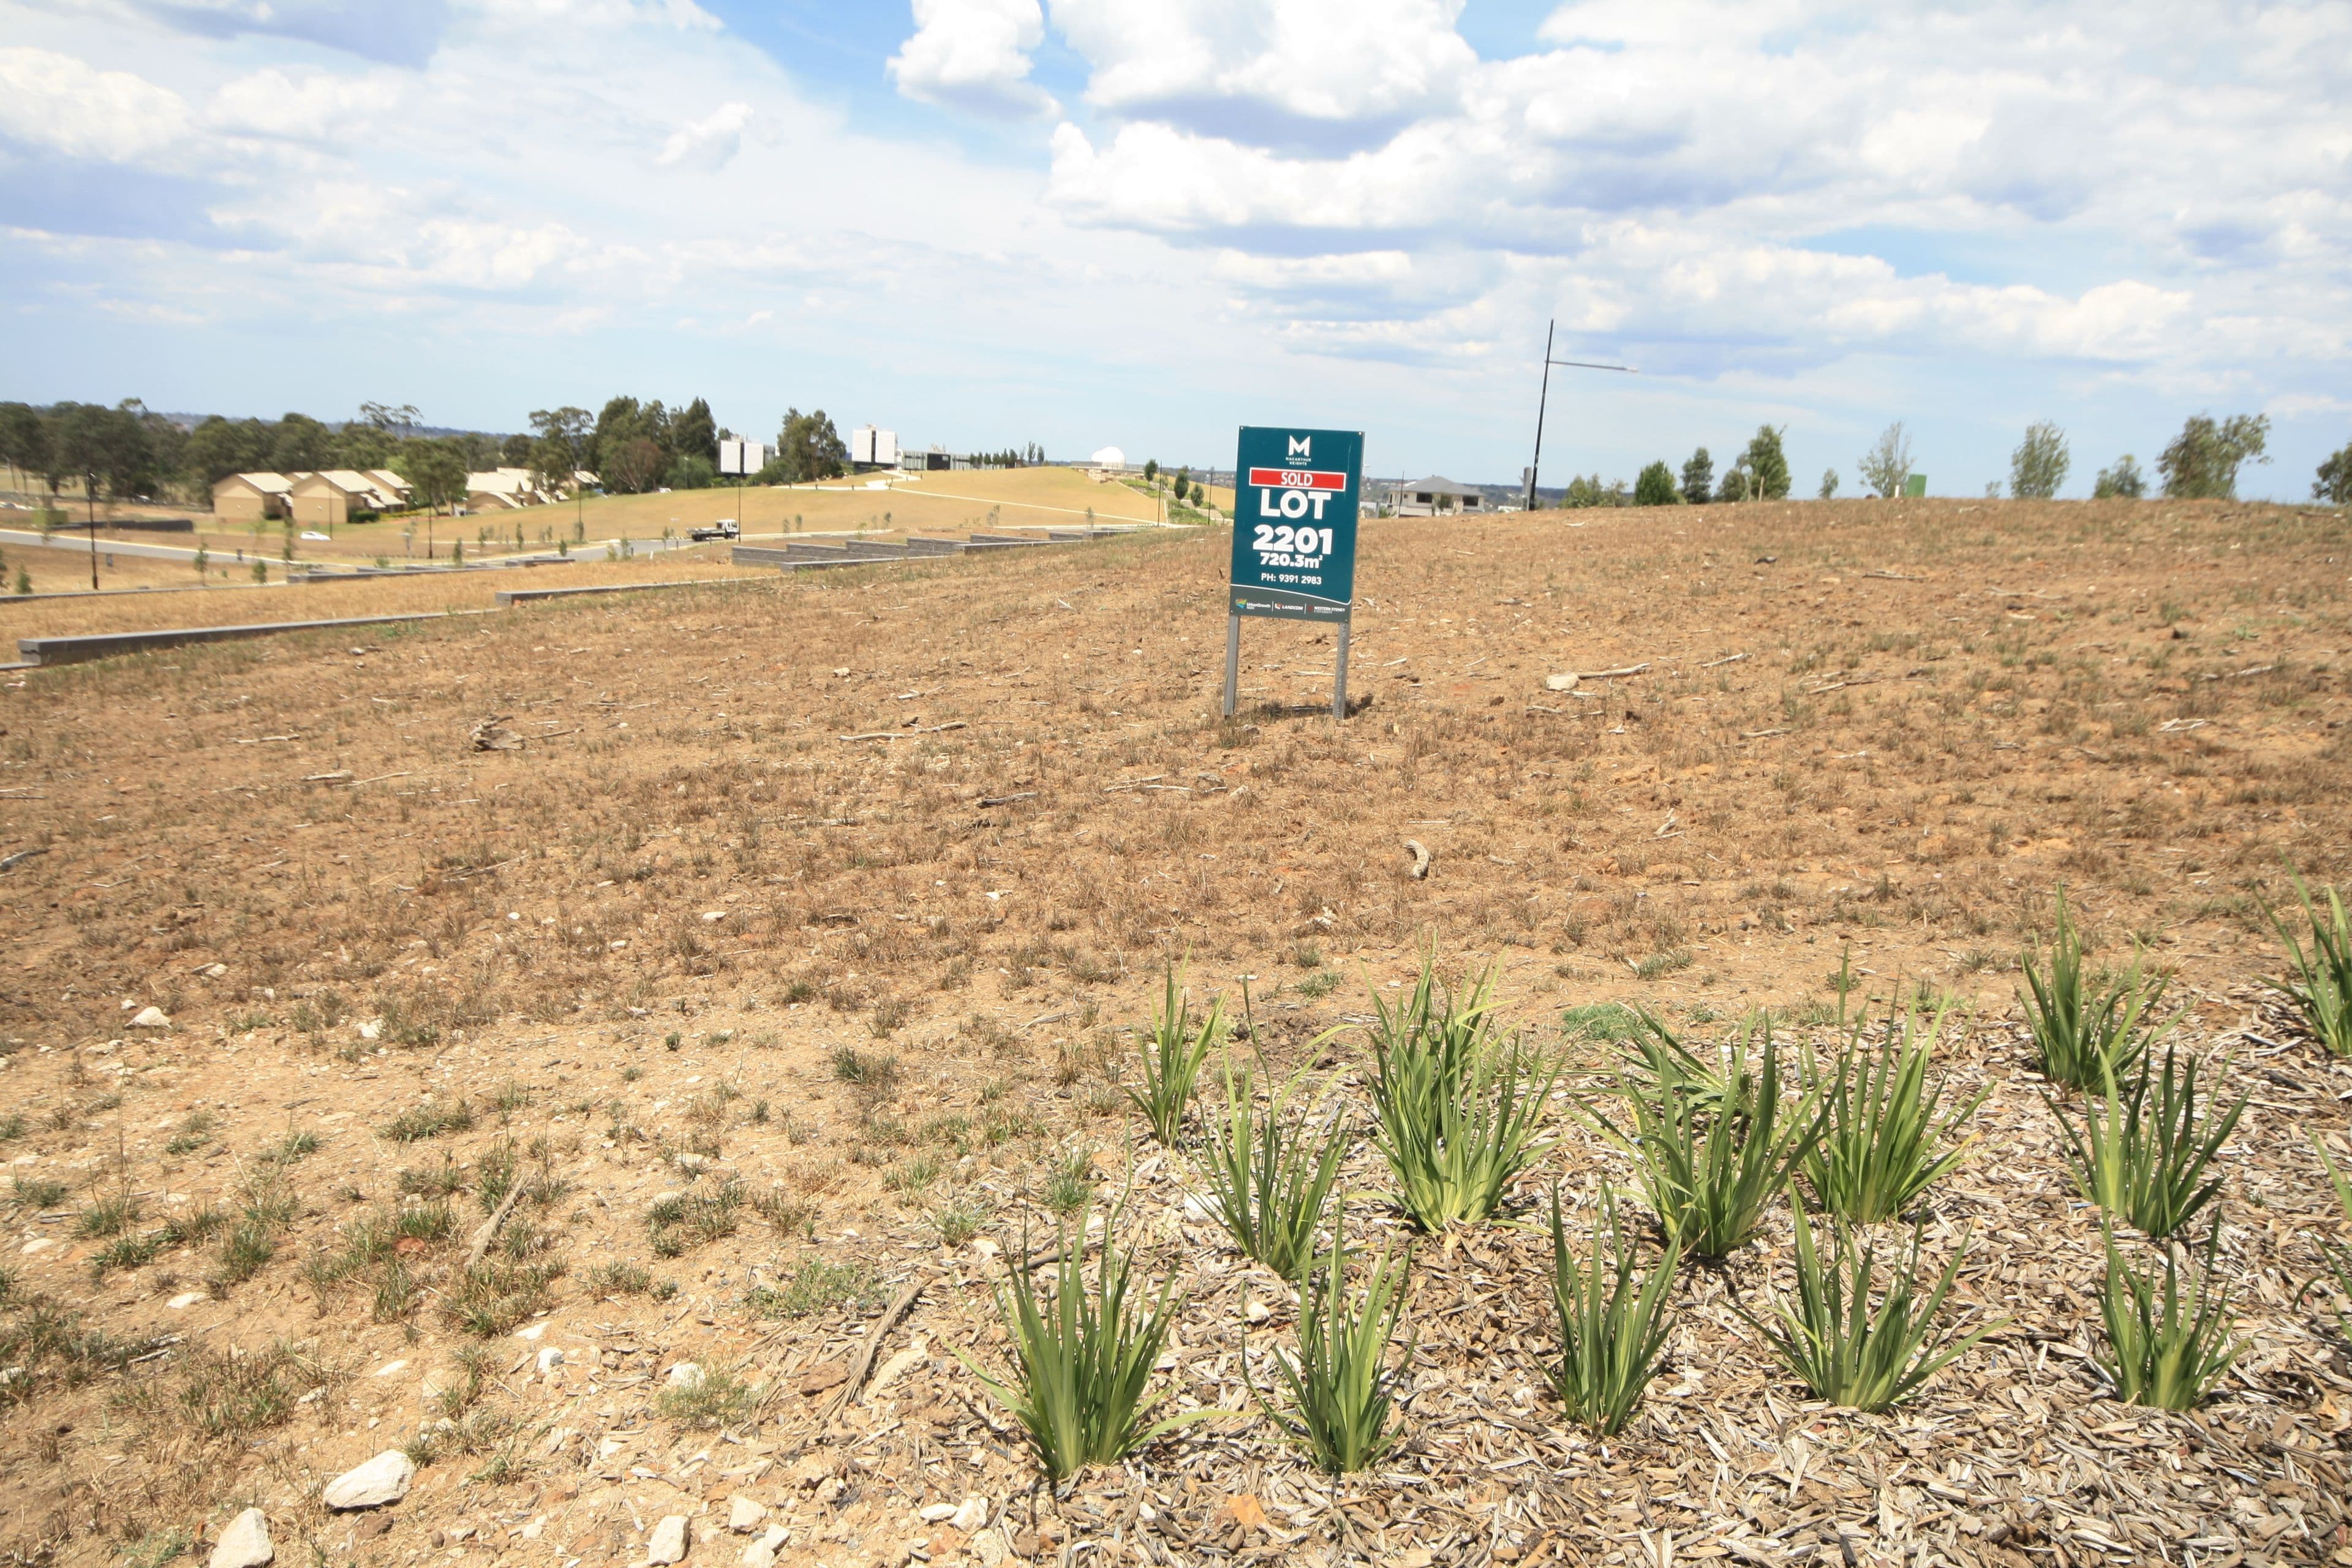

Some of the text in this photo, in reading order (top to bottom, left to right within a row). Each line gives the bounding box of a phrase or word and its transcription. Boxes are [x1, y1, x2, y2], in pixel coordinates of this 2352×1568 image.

[1289, 435, 1310, 457] M
[1281, 472, 1313, 486] SOLD
[1261, 489, 1332, 519] LOT
[1253, 524, 1332, 554] 2201
[1261, 573, 1322, 584] PH: 9391 2983
